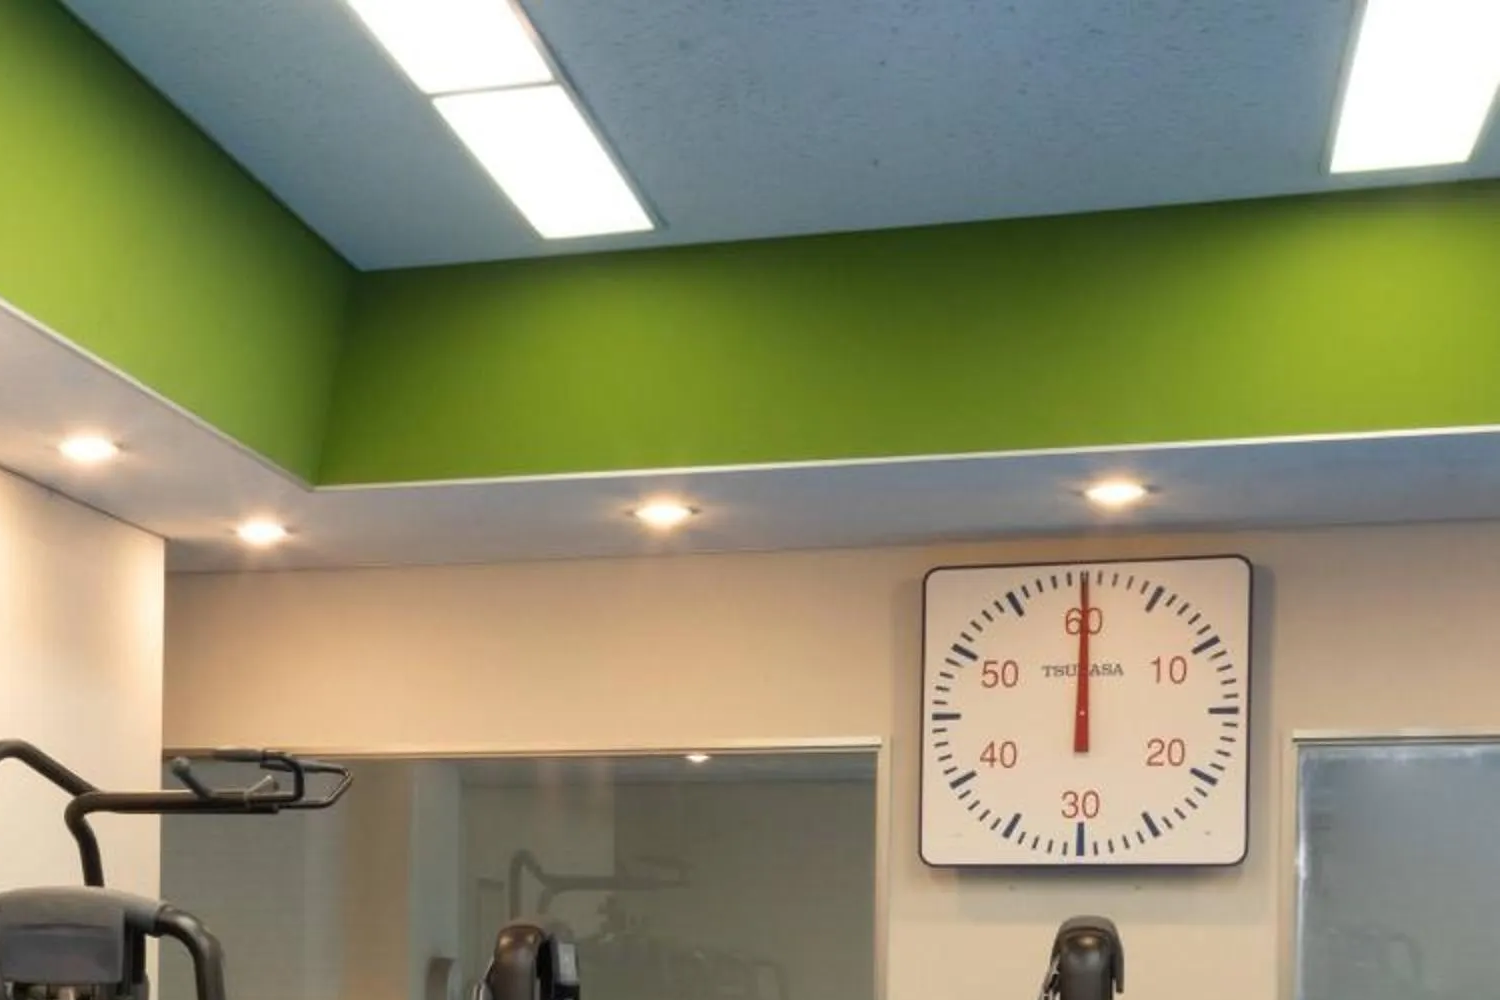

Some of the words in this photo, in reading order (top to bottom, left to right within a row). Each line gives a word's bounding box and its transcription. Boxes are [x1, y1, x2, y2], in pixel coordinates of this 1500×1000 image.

[1065, 607, 1103, 635] 60
[981, 660, 1019, 688] 50
[1041, 663, 1124, 678] TSUASA
[1150, 656, 1187, 685] 10
[979, 741, 1017, 768] 40
[1146, 738, 1185, 767] 20
[1061, 790, 1100, 819] 30
